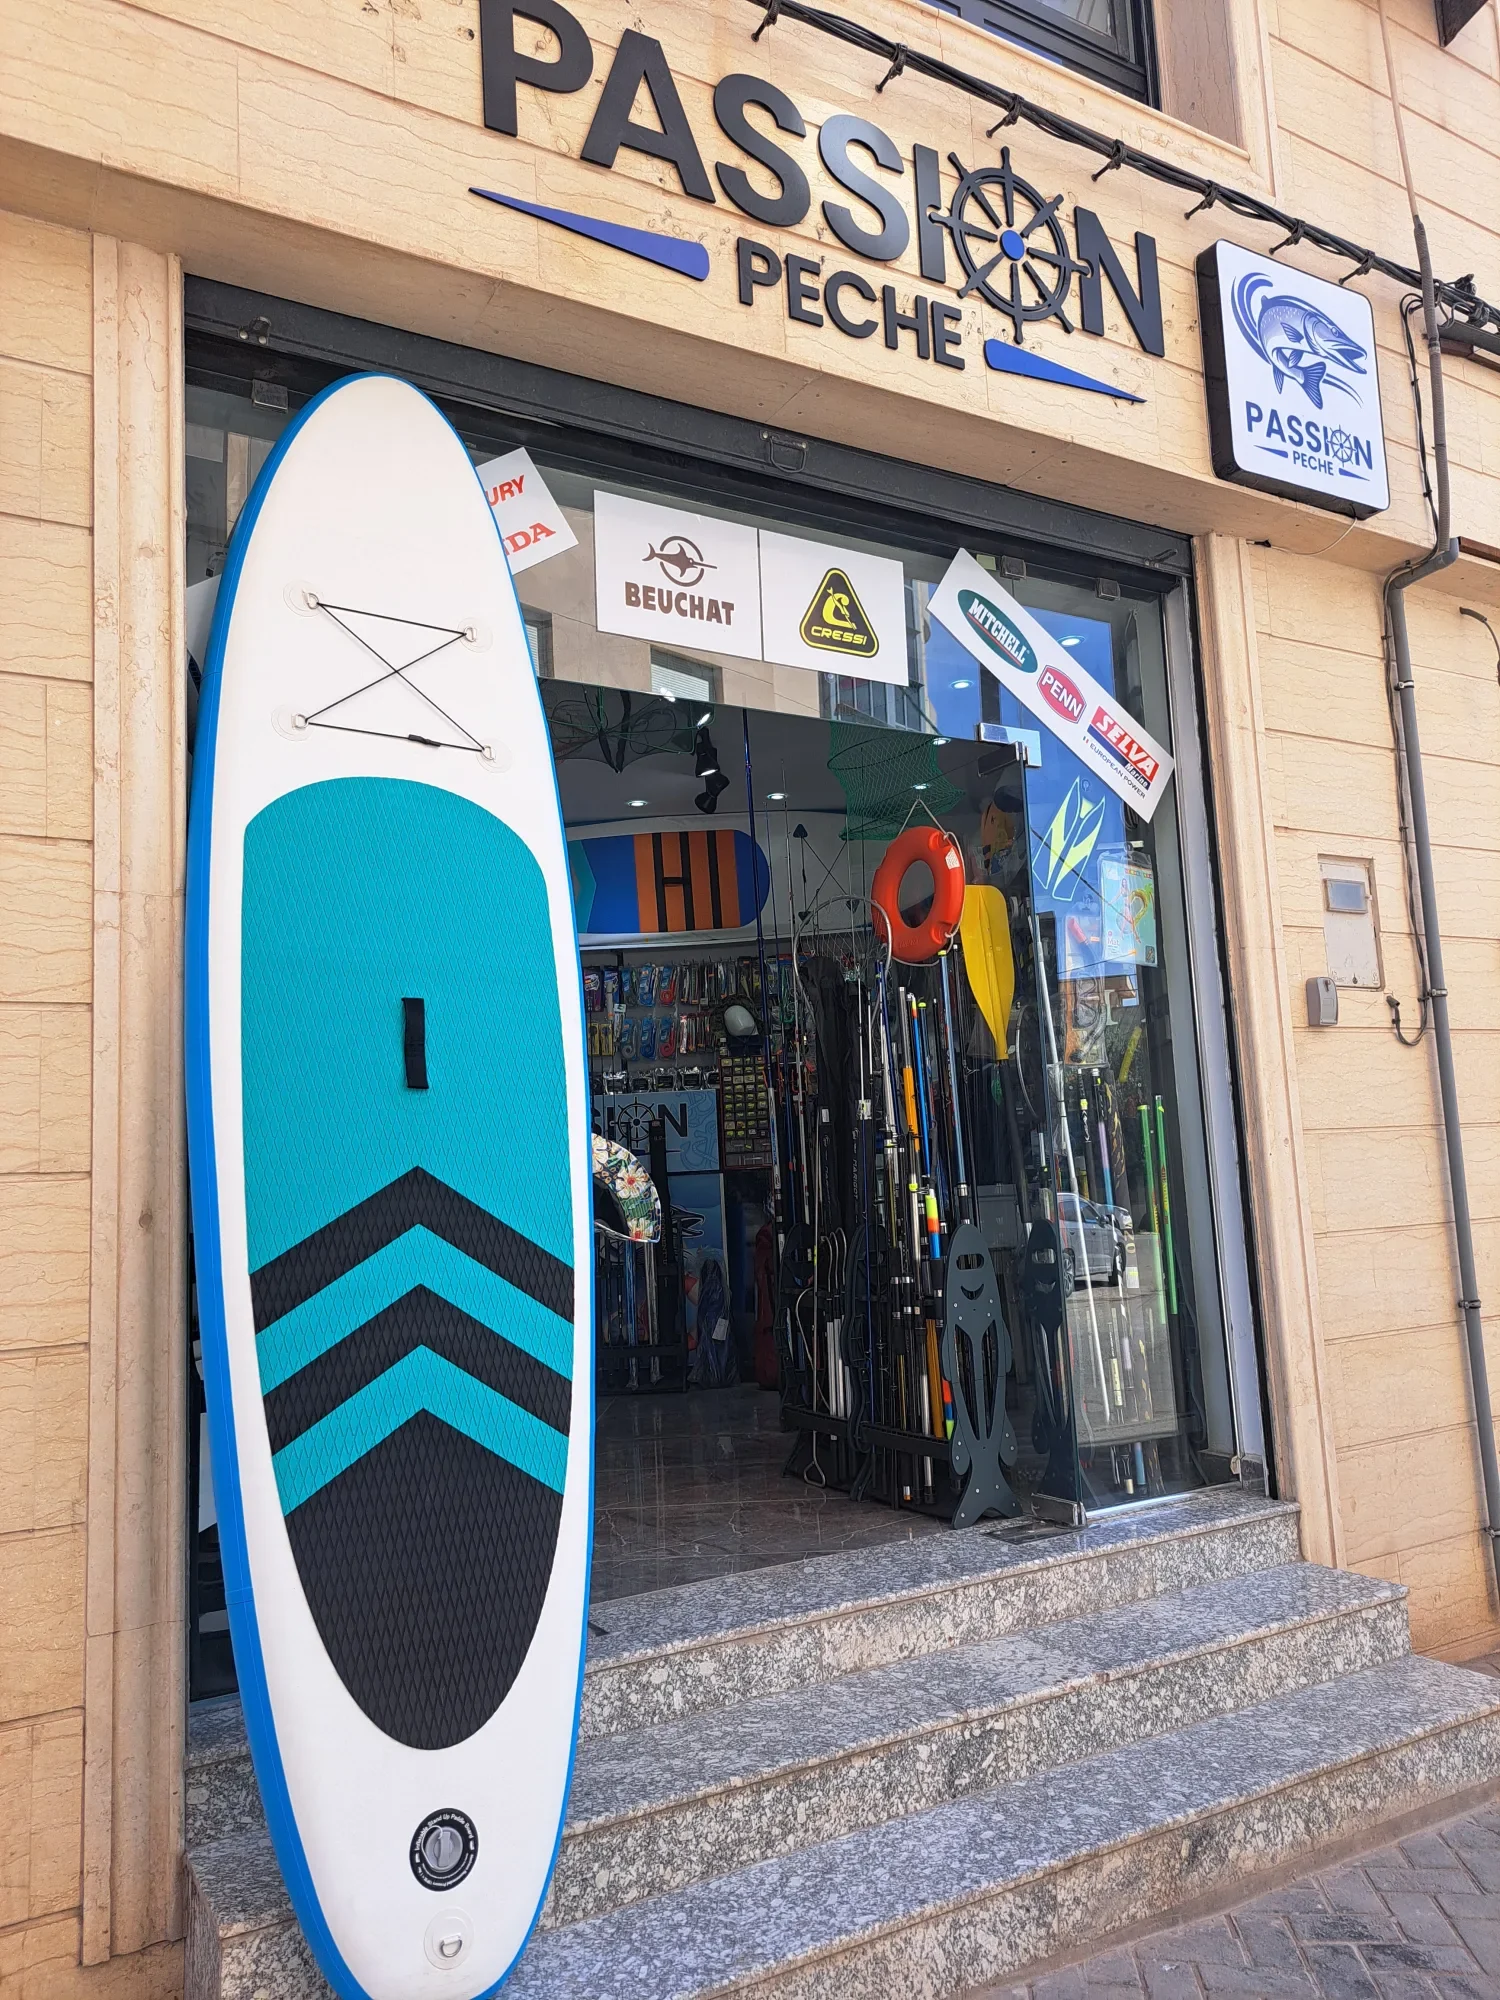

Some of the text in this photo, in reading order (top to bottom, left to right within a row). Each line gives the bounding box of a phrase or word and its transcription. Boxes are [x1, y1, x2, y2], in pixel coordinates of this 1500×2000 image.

[737, 236, 966, 370] PECHE
[1245, 400, 1373, 470] PASSION
[1293, 450, 1335, 476] PECHE
[625, 581, 735, 627] BEUCHAT
[810, 625, 868, 646] CRESSI
[968, 598, 1026, 665] MITCHELL
[1041, 672, 1083, 718] PENN
[1094, 713, 1159, 780] SELVA
[1090, 743, 1146, 800] EUROPEAN POWER
[1124, 762, 1149, 788] Marine
[427, 1814, 442, 1827] Stand
[450, 1814, 465, 1824] Paddle
[465, 1822, 474, 1838] Board
